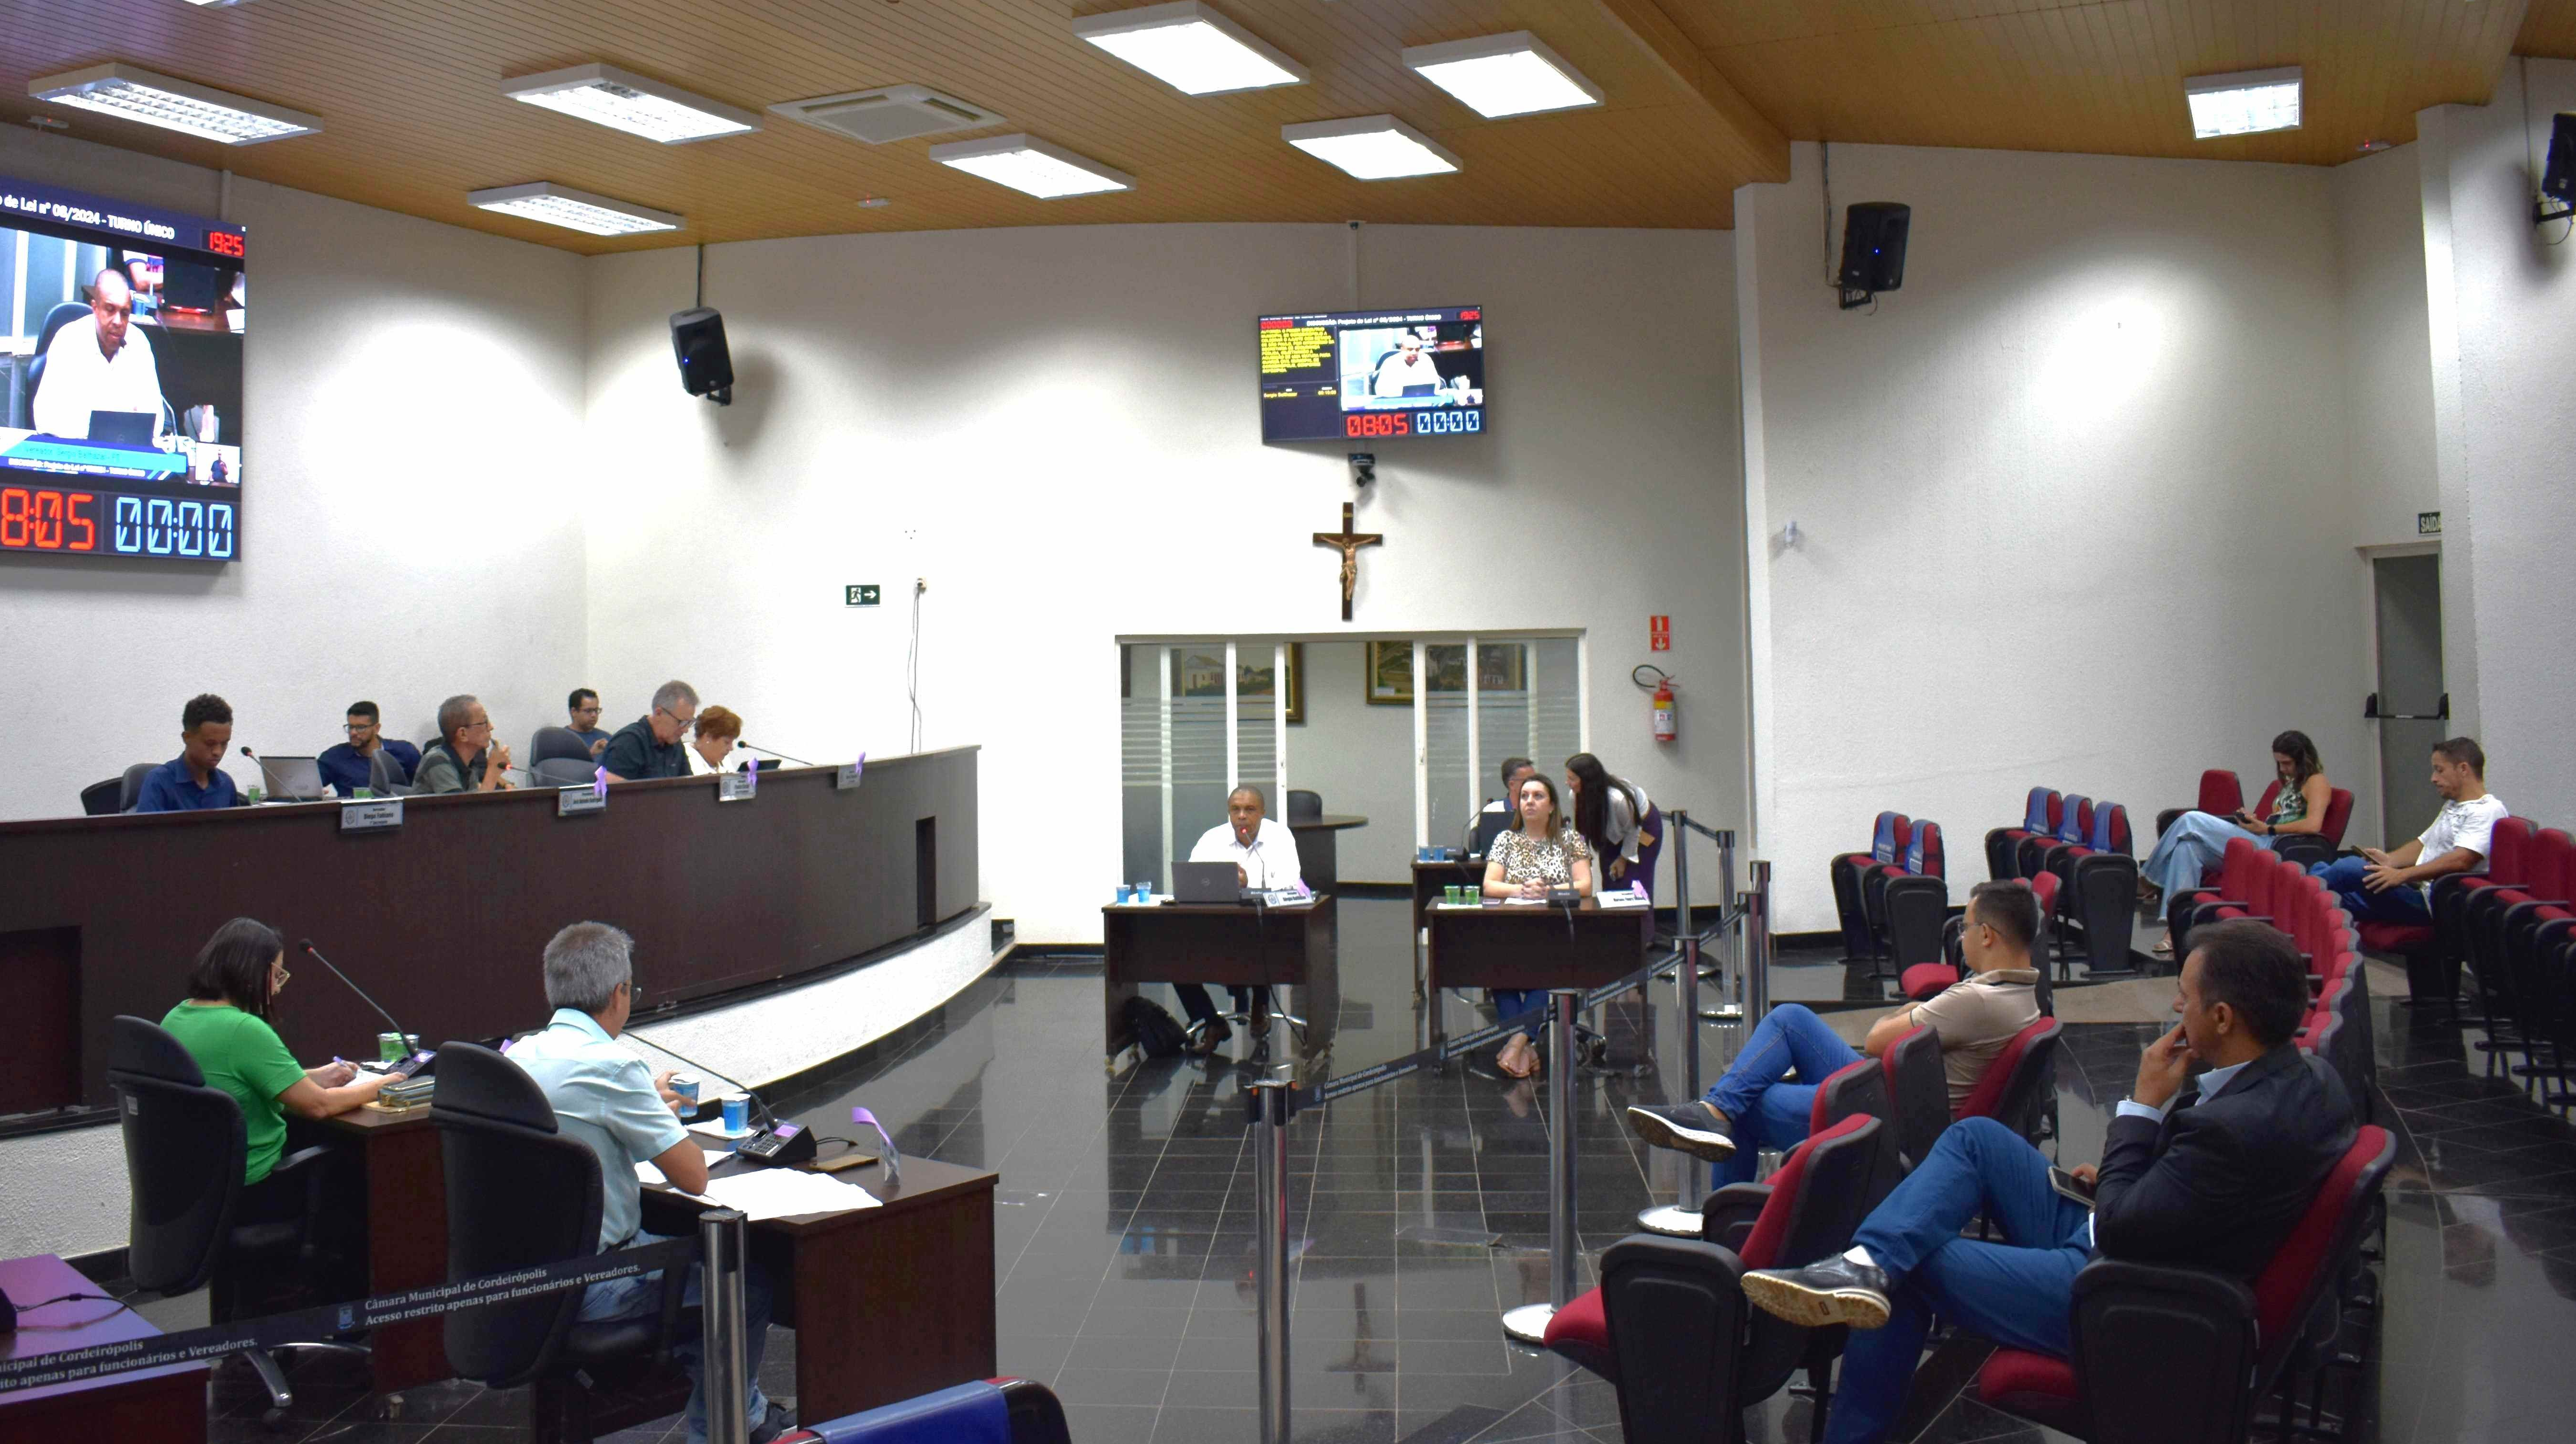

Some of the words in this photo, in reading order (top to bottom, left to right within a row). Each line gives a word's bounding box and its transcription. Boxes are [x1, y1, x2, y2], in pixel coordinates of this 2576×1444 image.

[4, 194, 18, 208] de
[21, 197, 37, 212] Lei
[53, 204, 100, 224] 08/2024
[107, 215, 142, 233] TURNO
[144, 220, 174, 239] ÚNICO
[1347, 413, 1408, 437] 08:05
[1417, 410, 1479, 433] 00:00
[116, 496, 232, 557] 00:00
[365, 1296, 406, 1311] Câmara
[409, 1285, 461, 1305] Municipal
[463, 1282, 476, 1293] de
[478, 1267, 547, 1290] Cordeirópolis
[365, 1310, 402, 1326] Acesso
[404, 1302, 445, 1320] restrito
[446, 1296, 484, 1313] apenas
[485, 1292, 509, 1308] para
[511, 1277, 574, 1297] funcionários
[583, 1263, 641, 1283] Vereadores.
[20, 1370, 65, 1387] apenas
[68, 1366, 96, 1381] para
[99, 1351, 176, 1373] funcionários
[189, 1338, 258, 1357] Vereadores.
[40, 1354, 57, 1366] de
[59, 1339, 144, 1363] Cordeirópolis
